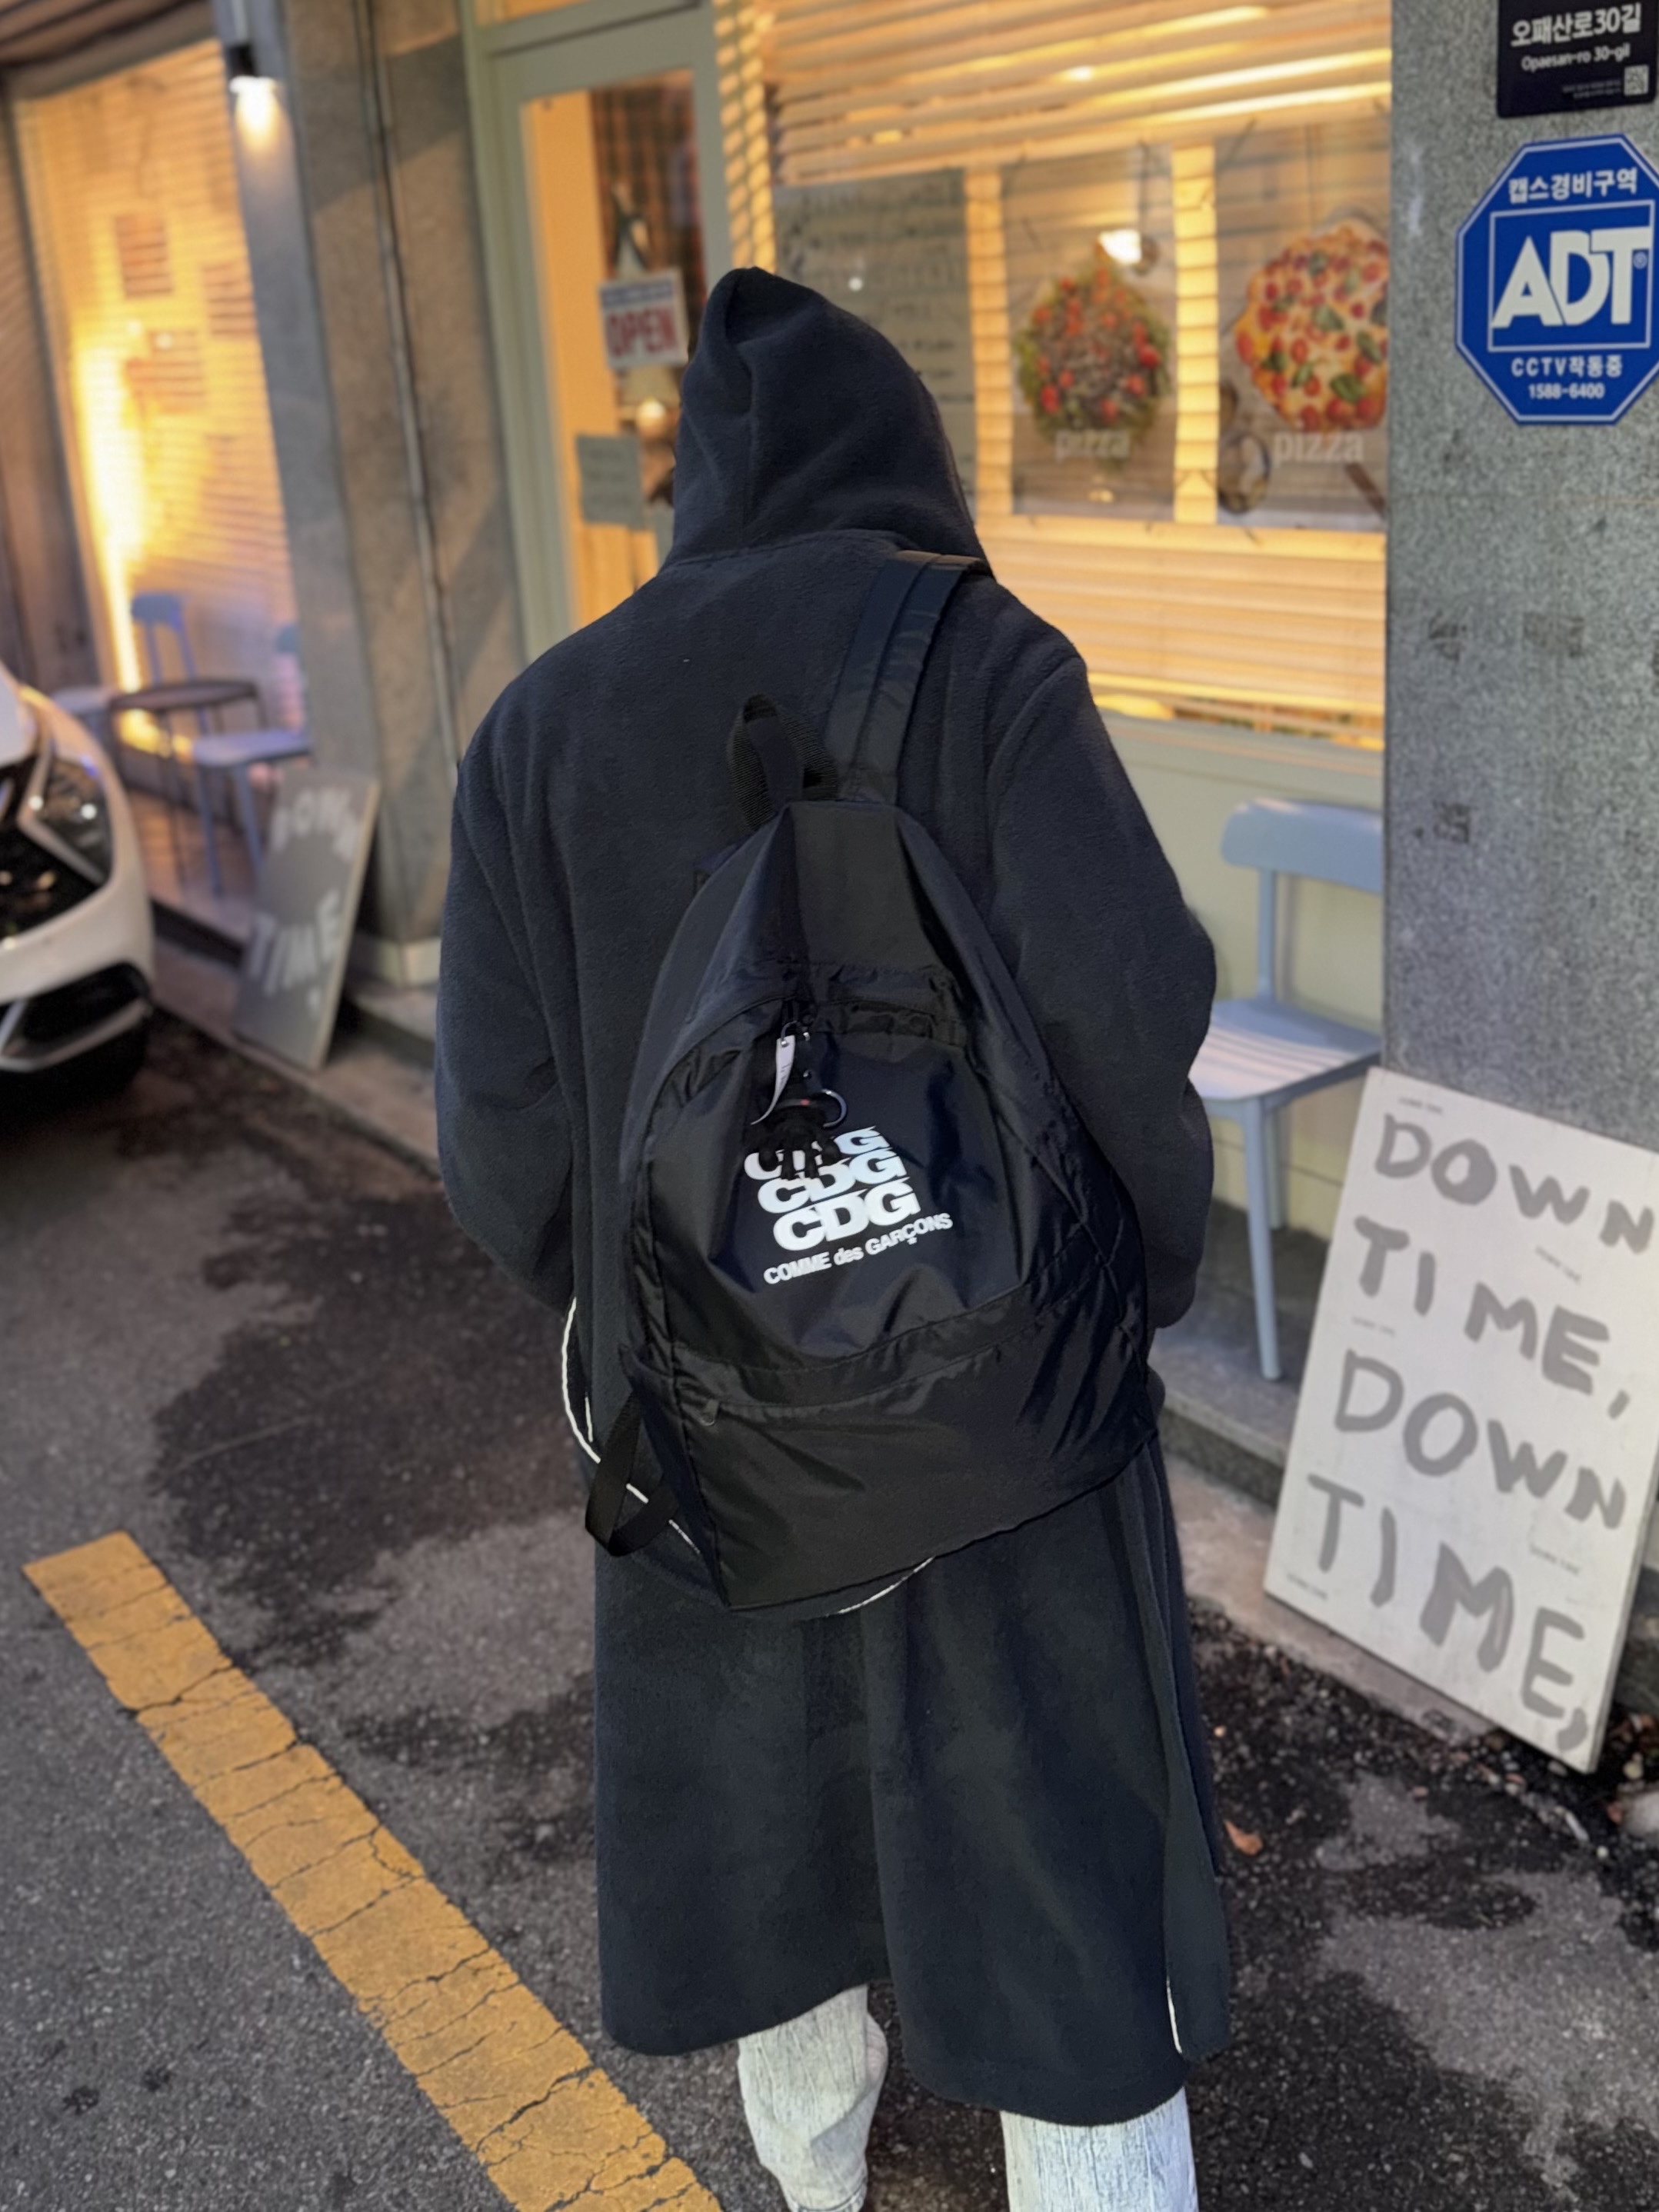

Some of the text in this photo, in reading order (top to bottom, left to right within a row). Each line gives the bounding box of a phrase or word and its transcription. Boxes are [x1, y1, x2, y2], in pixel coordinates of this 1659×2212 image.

[1511, 2, 1641, 47] 오패산로30길
[1521, 42, 1631, 73] Opaesan-ro 30-gil
[1508, 167, 1638, 204] 캡스경비구역
[1491, 226, 1651, 328] ADT
[1528, 382, 1605, 399] 1588-6400
[1274, 429, 1364, 465] pizza
[758, 1147, 908, 1214] CDG
[773, 1176, 921, 1251] CDG
[1374, 1113, 1655, 1254] DOWN
[763, 1213, 954, 1284] COMME des GARÇONS
[1354, 1215, 1631, 1419] TIME,
[1334, 1348, 1626, 1530] DOWN
